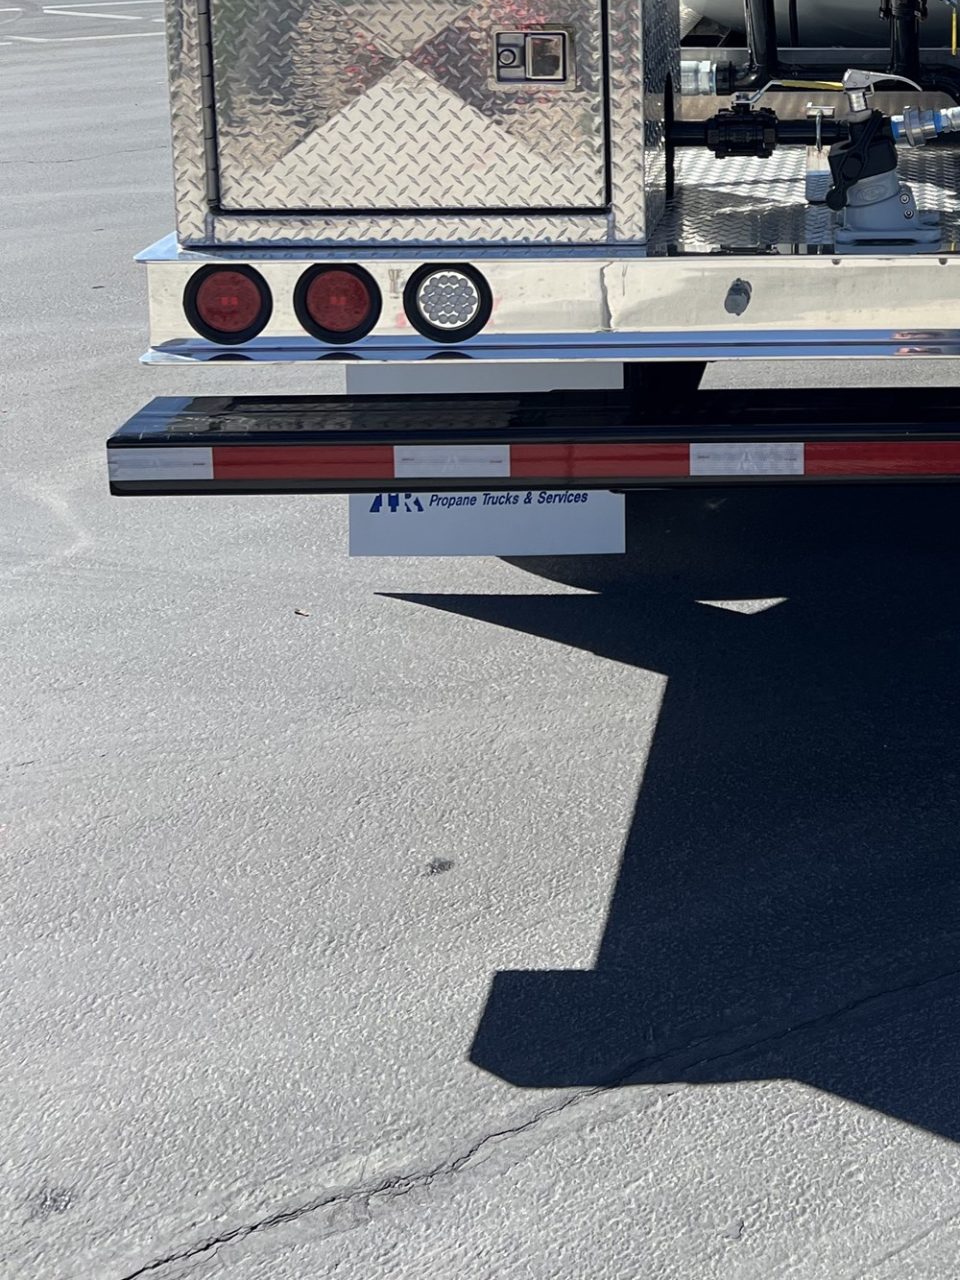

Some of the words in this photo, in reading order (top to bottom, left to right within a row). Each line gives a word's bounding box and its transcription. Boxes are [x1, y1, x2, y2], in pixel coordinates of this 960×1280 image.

[429, 494, 477, 509] Propane
[482, 492, 520, 506] Trucks
[523, 491, 533, 505] &
[537, 490, 589, 505] Services
